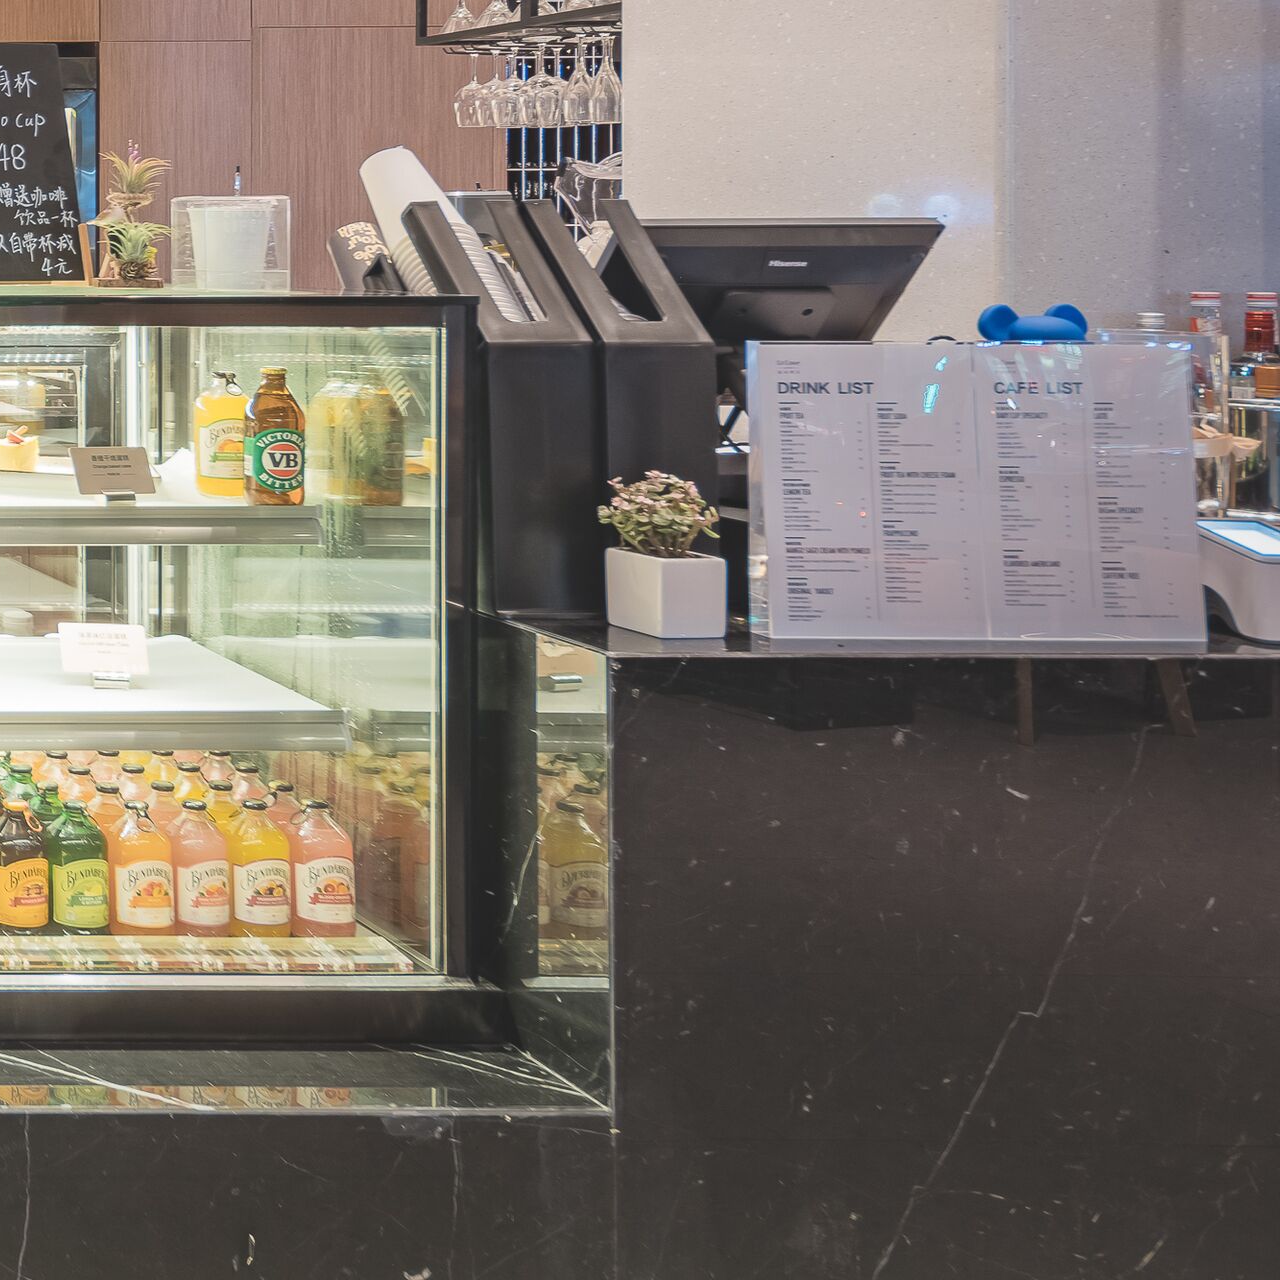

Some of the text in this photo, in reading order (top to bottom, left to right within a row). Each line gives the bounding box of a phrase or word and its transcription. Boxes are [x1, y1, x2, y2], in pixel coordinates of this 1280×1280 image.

[13, 209, 79, 228] 饮品一杯
[41, 257, 73, 277] 4元
[777, 381, 875, 395] DRINK LIST
[993, 381, 1084, 395] CAFE LIST
[255, 431, 305, 449] VICTORIA
[267, 452, 299, 469] VB
[258, 472, 303, 489] BITTER
